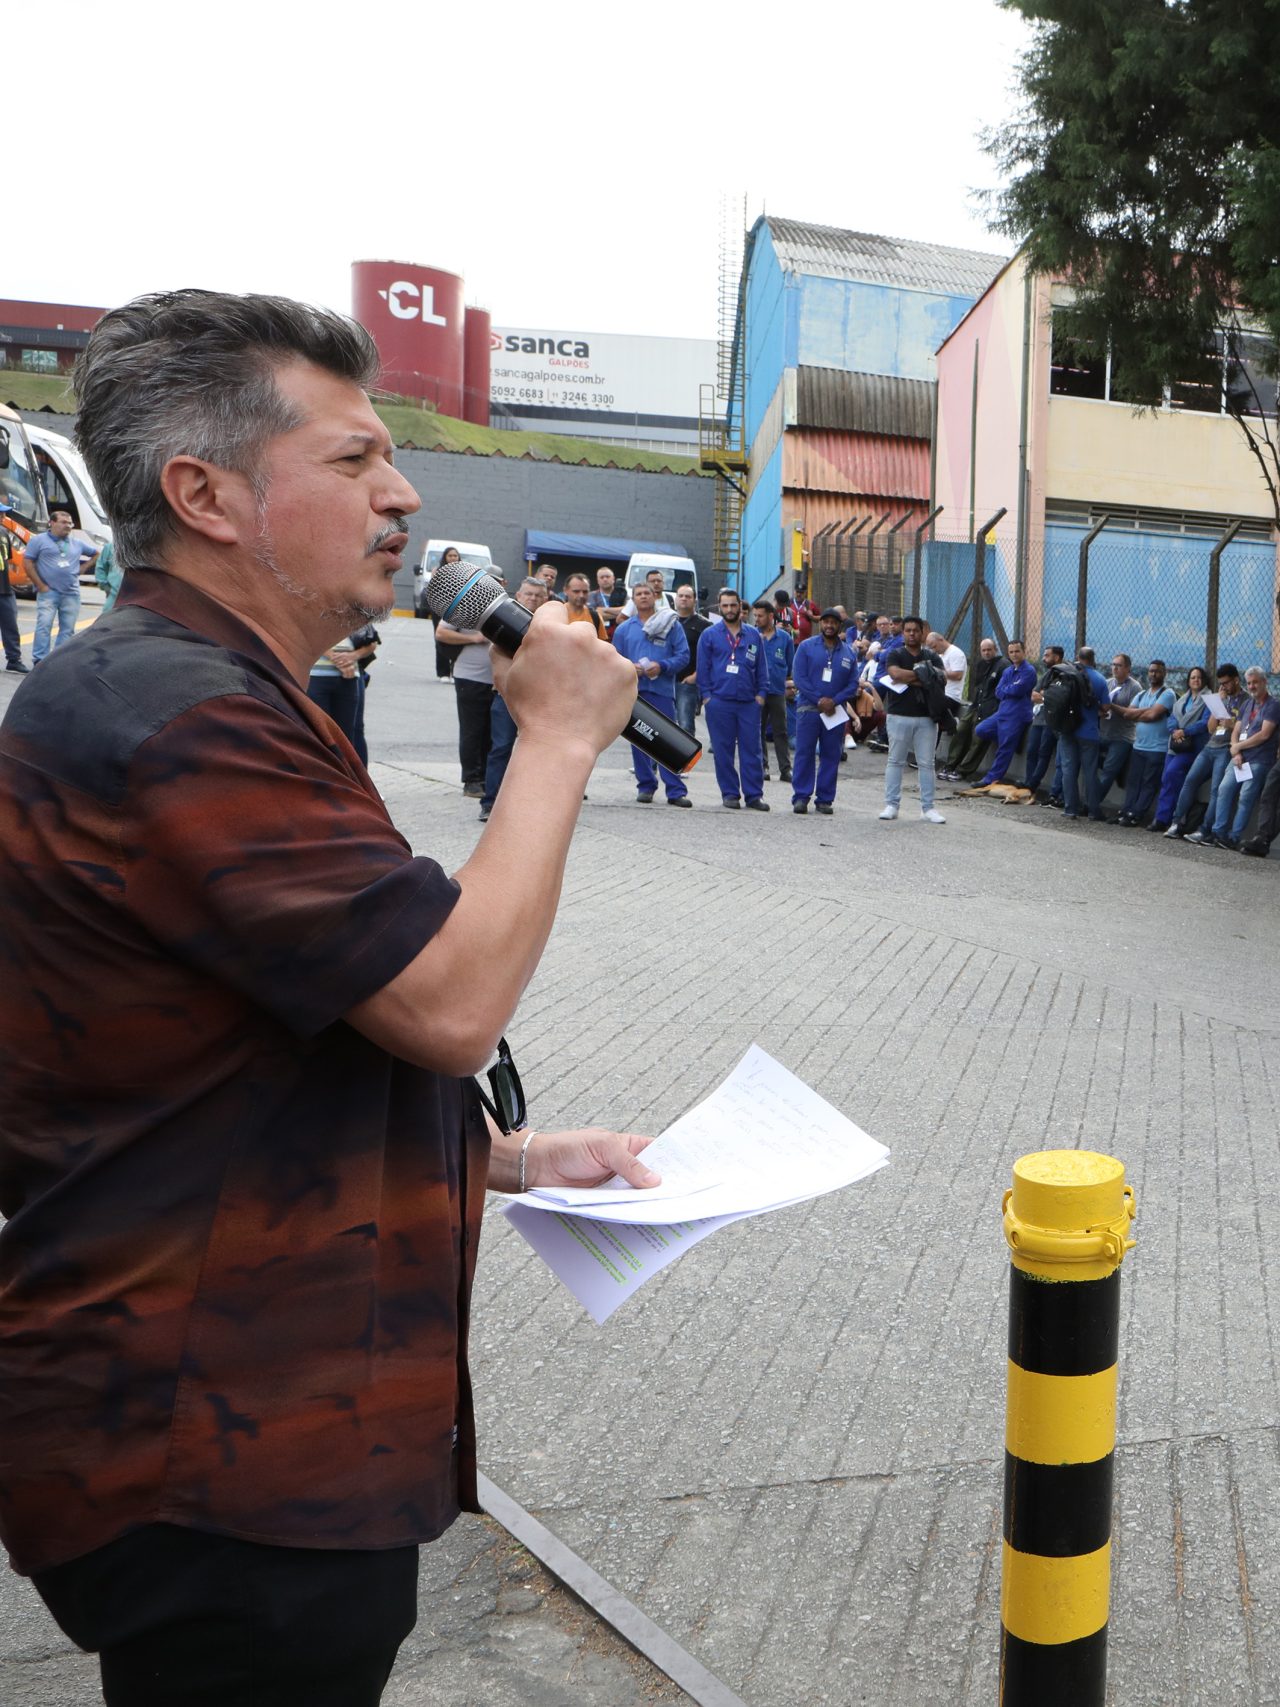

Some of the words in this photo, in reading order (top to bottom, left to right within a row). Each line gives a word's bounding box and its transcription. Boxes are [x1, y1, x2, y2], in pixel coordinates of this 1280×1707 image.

[388, 281, 446, 327] CL
[505, 335, 590, 358] sanca
[491, 386, 516, 397] 5092
[519, 388, 544, 399] 6683
[562, 391, 587, 402] 3246
[591, 393, 615, 404] 3300
